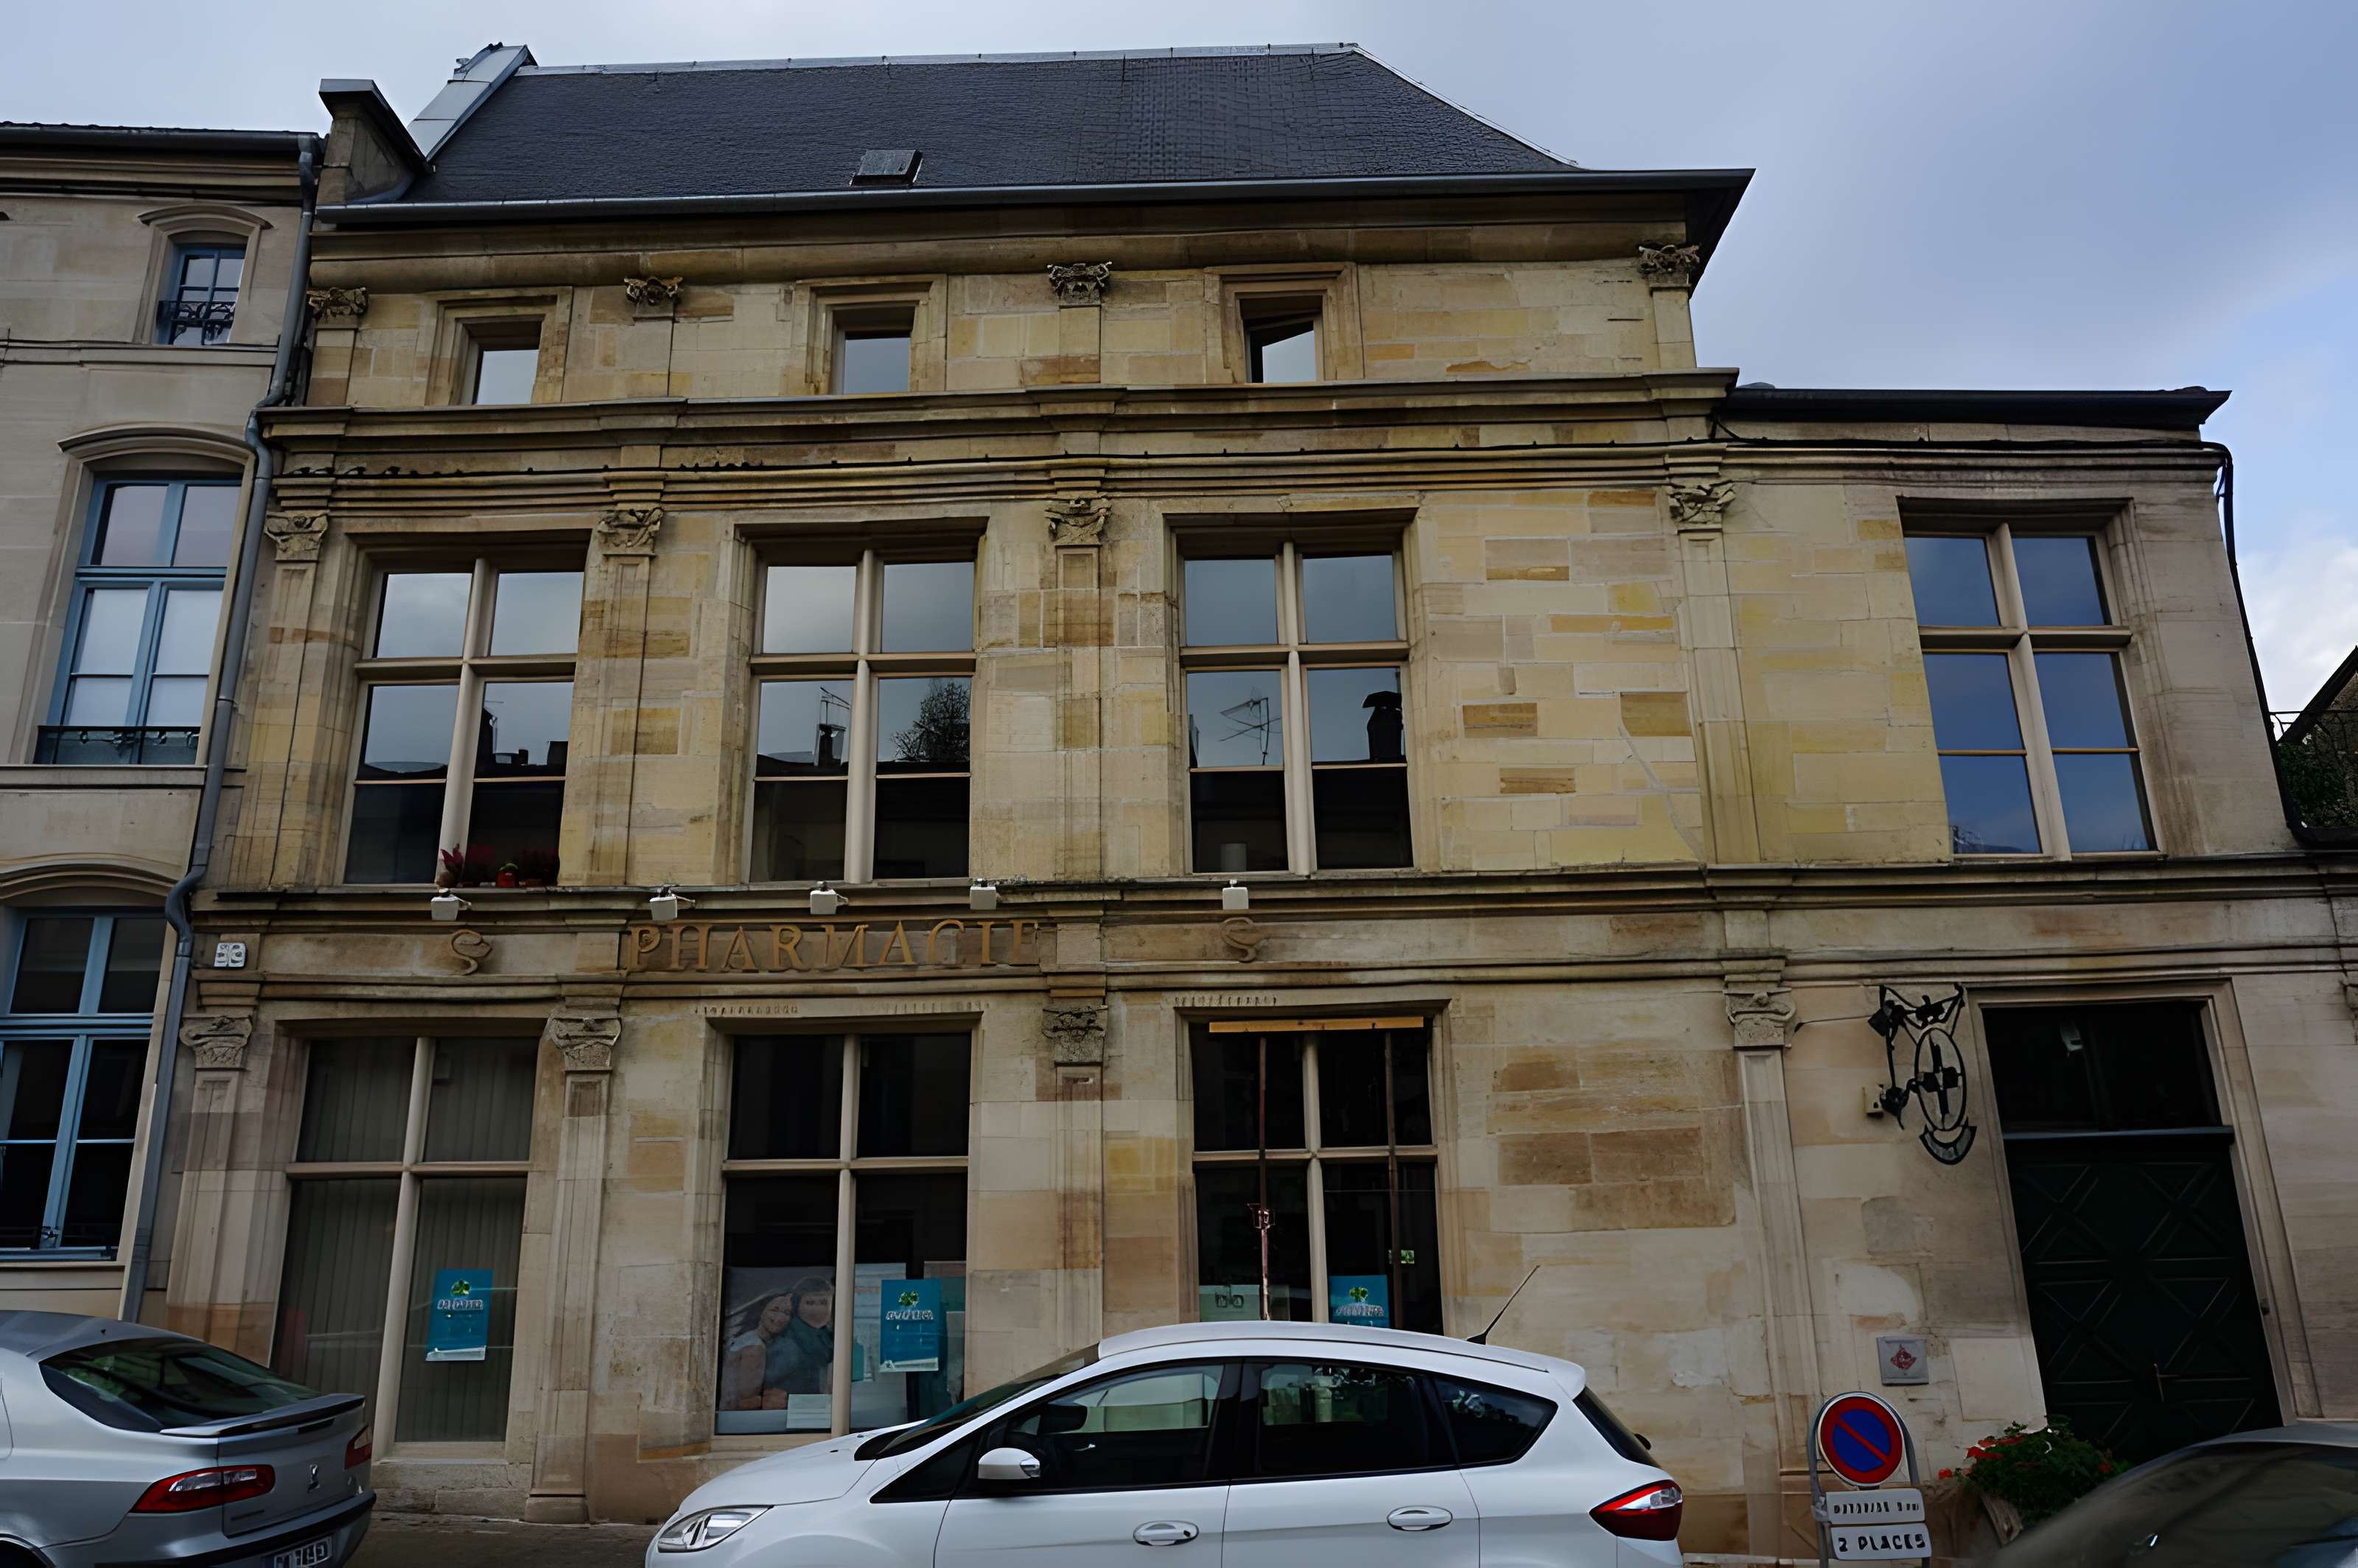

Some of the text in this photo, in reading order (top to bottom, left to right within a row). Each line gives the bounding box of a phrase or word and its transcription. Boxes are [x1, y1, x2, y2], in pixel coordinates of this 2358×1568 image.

[629, 919, 1038, 970] PHARMACIE
[1838, 1533, 1925, 1553] 2 PLACES
